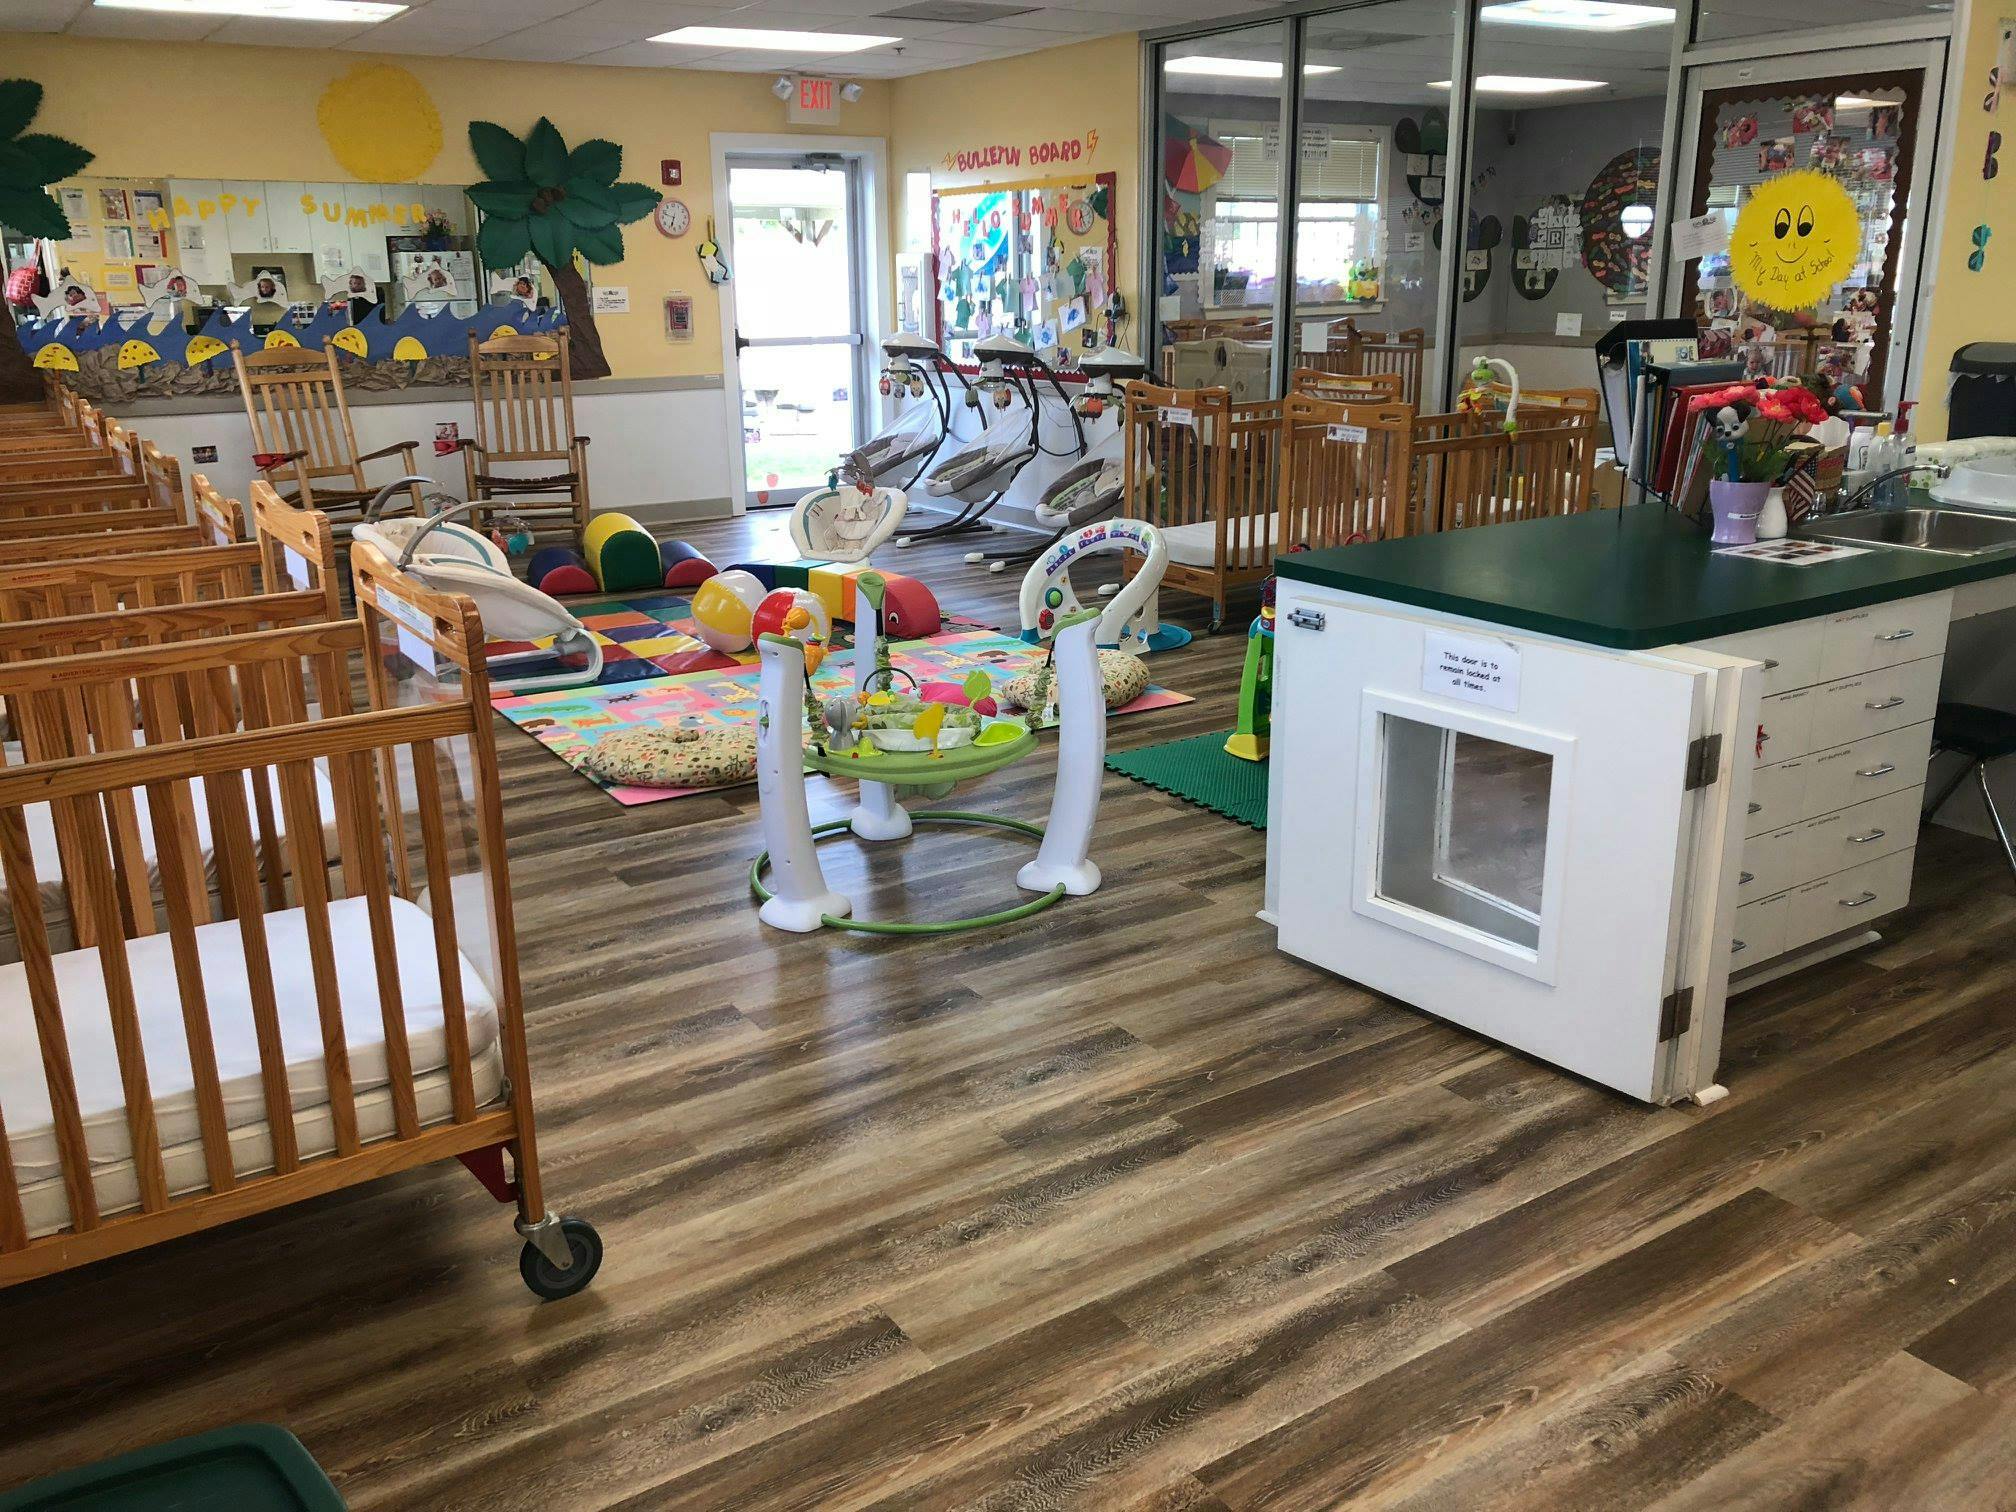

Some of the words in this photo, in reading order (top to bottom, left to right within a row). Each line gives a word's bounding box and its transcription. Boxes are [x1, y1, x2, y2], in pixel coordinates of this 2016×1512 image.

[800, 79, 832, 111] EXIT
[957, 145, 1021, 173] BULLETIN
[1029, 139, 1082, 165] BOARD
[300, 193, 426, 229] SUMMER
[952, 208, 1001, 237] HELLO
[1012, 193, 1083, 231] SUMMER
[1749, 251, 1768, 286] My
[1770, 266, 1789, 291] Day
[1795, 268, 1806, 281] at
[1809, 249, 1836, 275] School
[1439, 664, 1464, 675] remain
[1466, 668, 1490, 681] locked
[1493, 675, 1502, 683] at
[1444, 651, 1459, 662] This
[1462, 656, 1478, 666] door
[1481, 660, 1487, 668] is
[1452, 678, 1461, 686] all
